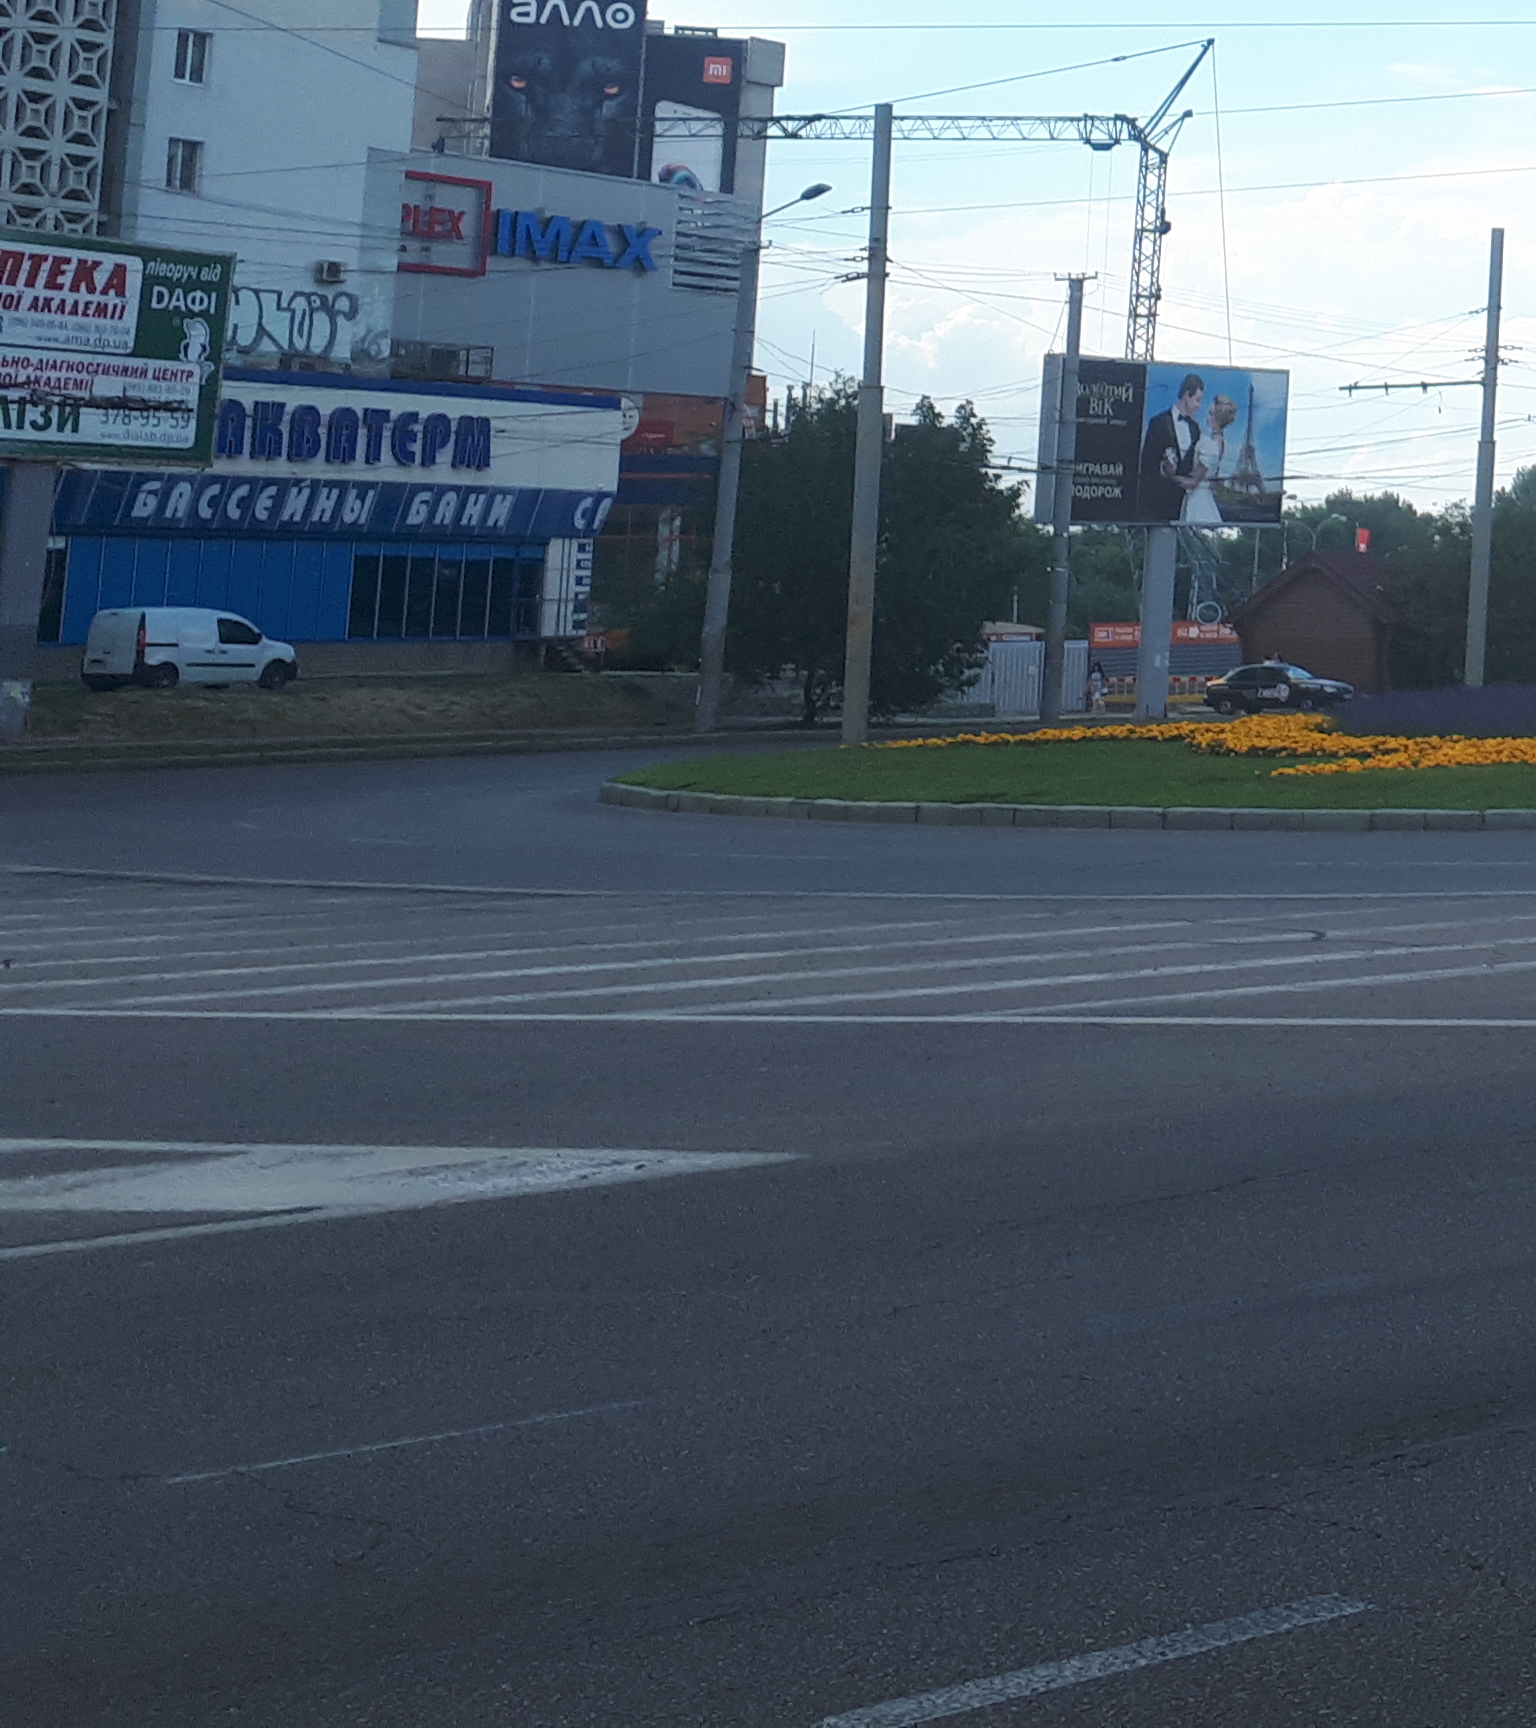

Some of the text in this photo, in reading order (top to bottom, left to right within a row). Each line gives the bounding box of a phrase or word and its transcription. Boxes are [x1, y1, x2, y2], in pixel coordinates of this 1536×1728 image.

[497, 208, 660, 272] IMAX
[145, 257, 222, 283] ліворуч від
[0, 290, 129, 321] ОЇ АКАДЕМІЇ
[151, 366, 195, 382] ЦЕНТР
[1088, 396, 1114, 416] ВІК
[214, 398, 491, 470] АКВАТЕРМ
[1075, 462, 1124, 476] ИГРАВАЙ
[131, 480, 376, 525] БАССЕЙНЫ
[405, 490, 514, 527] БАНИ
